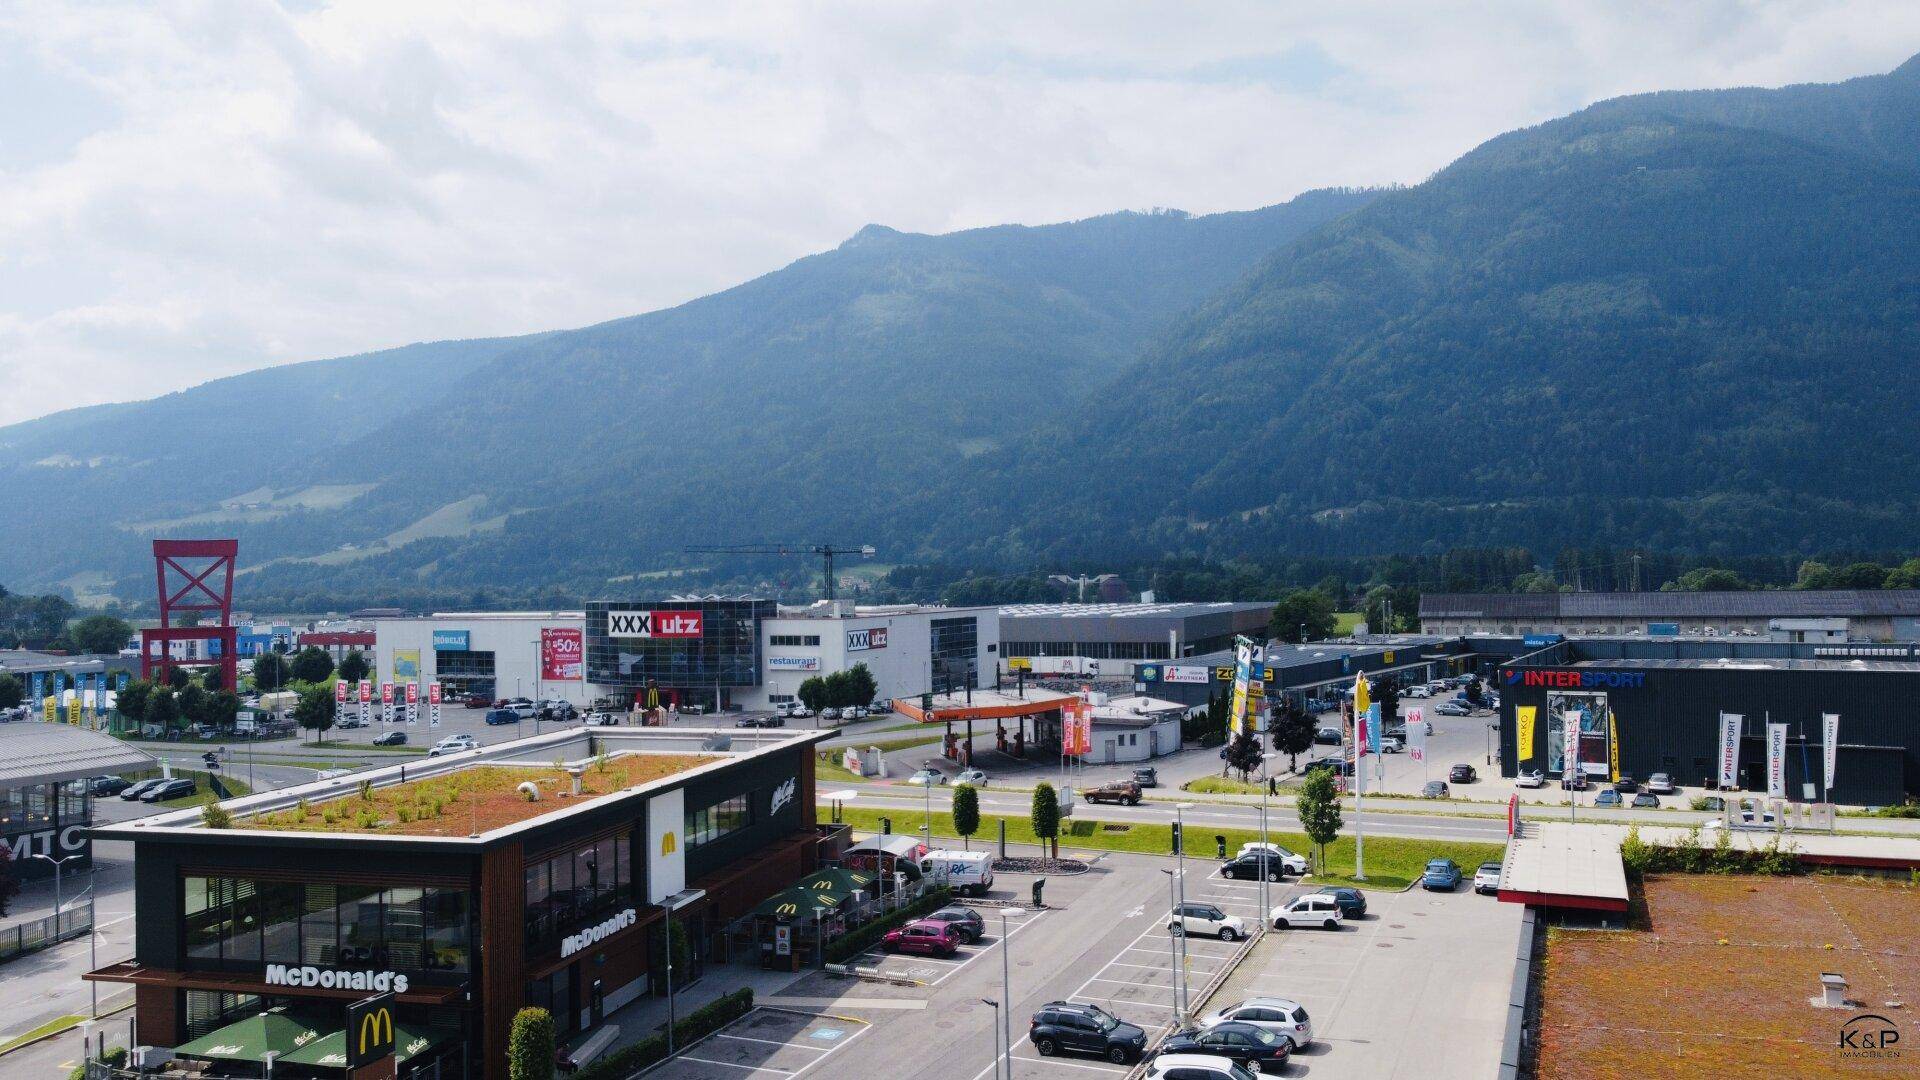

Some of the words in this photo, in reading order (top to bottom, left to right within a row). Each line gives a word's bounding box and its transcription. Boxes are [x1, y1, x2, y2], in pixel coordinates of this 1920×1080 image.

[769, 657, 816, 667] restaurant
[1524, 670, 1646, 688] INTERSPORT
[1725, 721, 1736, 772] INTERSPORT
[1773, 730, 1781, 783] INTERSPORT
[560, 908, 636, 958] McDonald's
[265, 964, 409, 993] McDonald's
